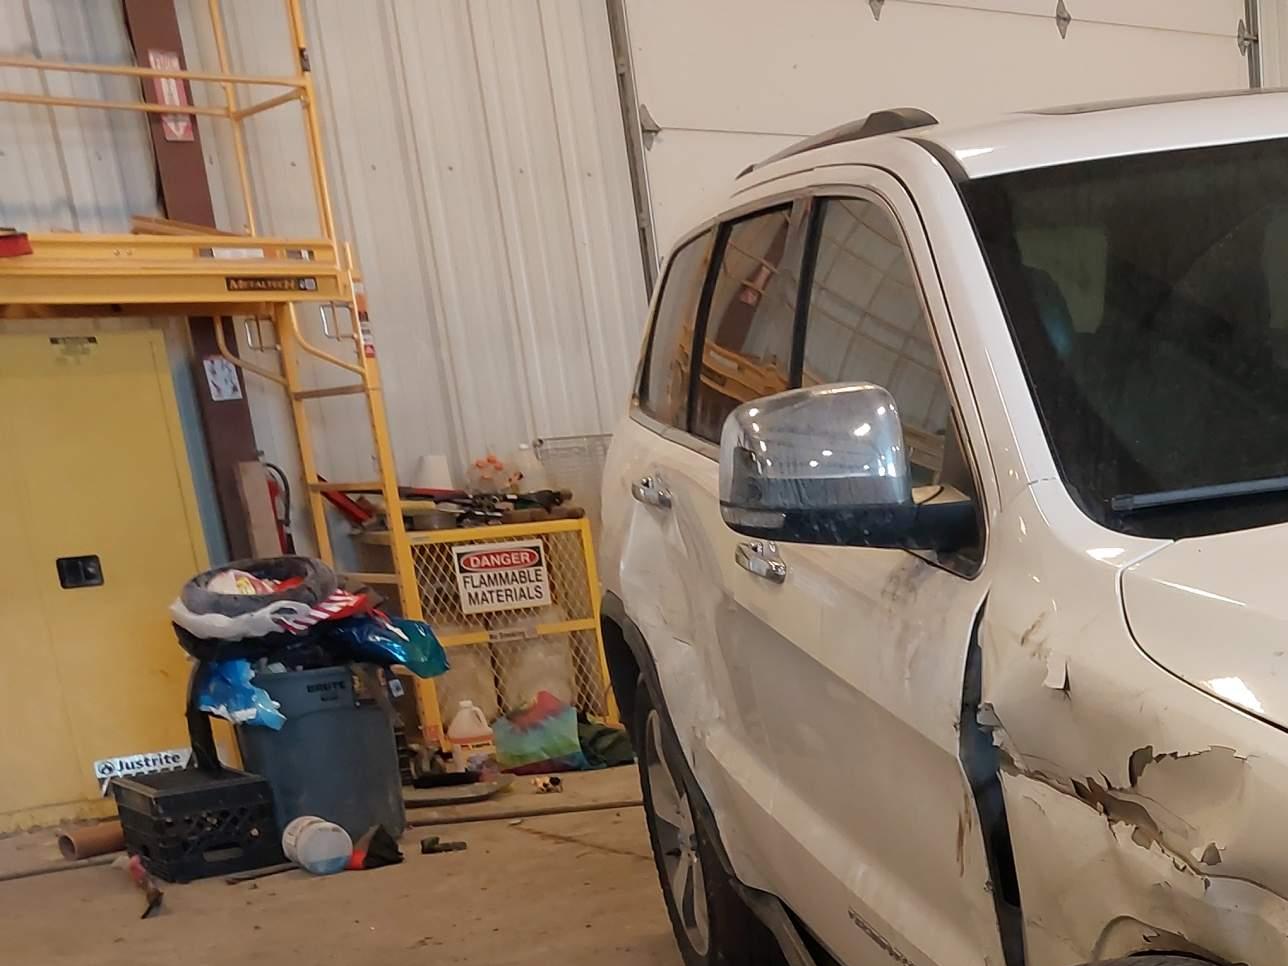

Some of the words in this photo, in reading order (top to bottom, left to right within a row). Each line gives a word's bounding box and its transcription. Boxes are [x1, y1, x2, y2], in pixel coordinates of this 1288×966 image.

[470, 552, 530, 568] DANGER
[463, 569, 542, 589] FLAMMABLE
[468, 586, 543, 606] MATERIALS
[116, 753, 181, 772] Justrite
